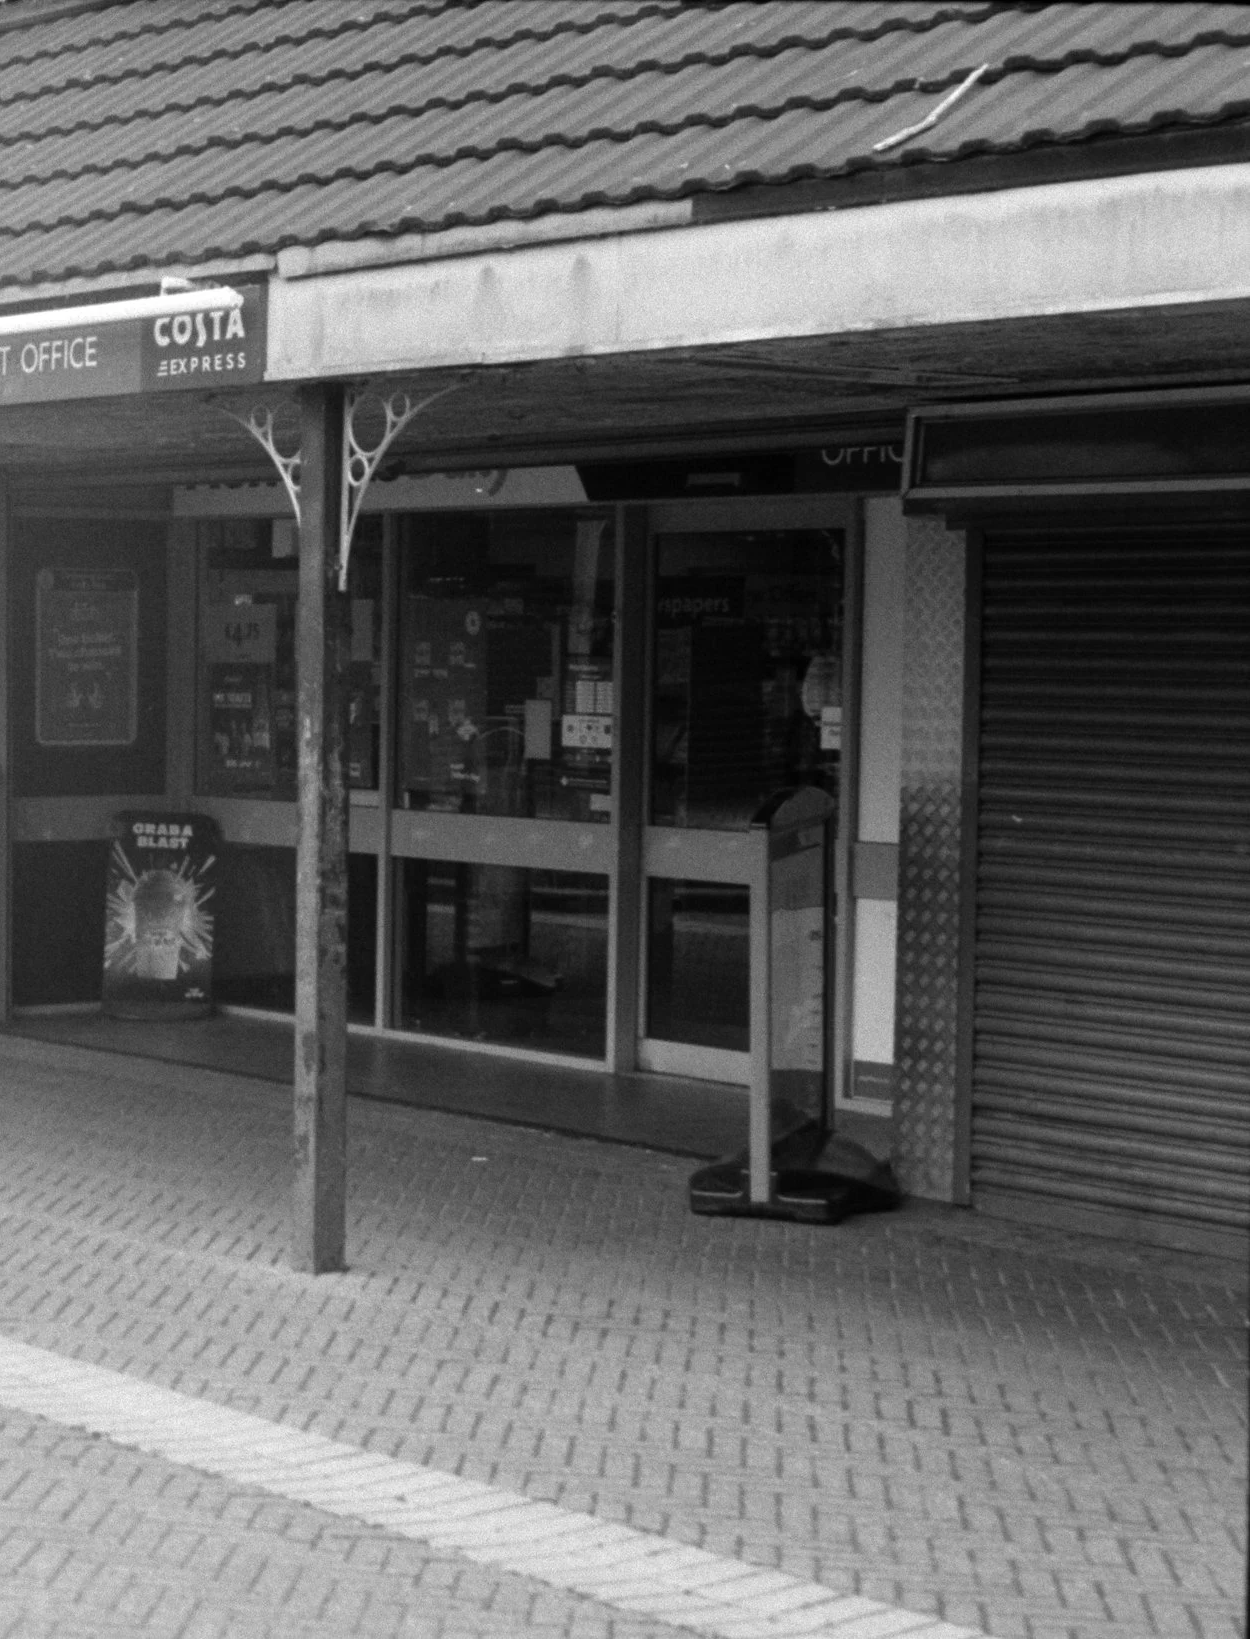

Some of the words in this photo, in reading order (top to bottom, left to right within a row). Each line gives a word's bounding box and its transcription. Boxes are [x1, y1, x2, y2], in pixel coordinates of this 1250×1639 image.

[152, 308, 246, 348] COSTA
[20, 336, 98, 374] OFFICE
[168, 351, 248, 376] EXPRESS
[137, 835, 190, 849] BLAST
